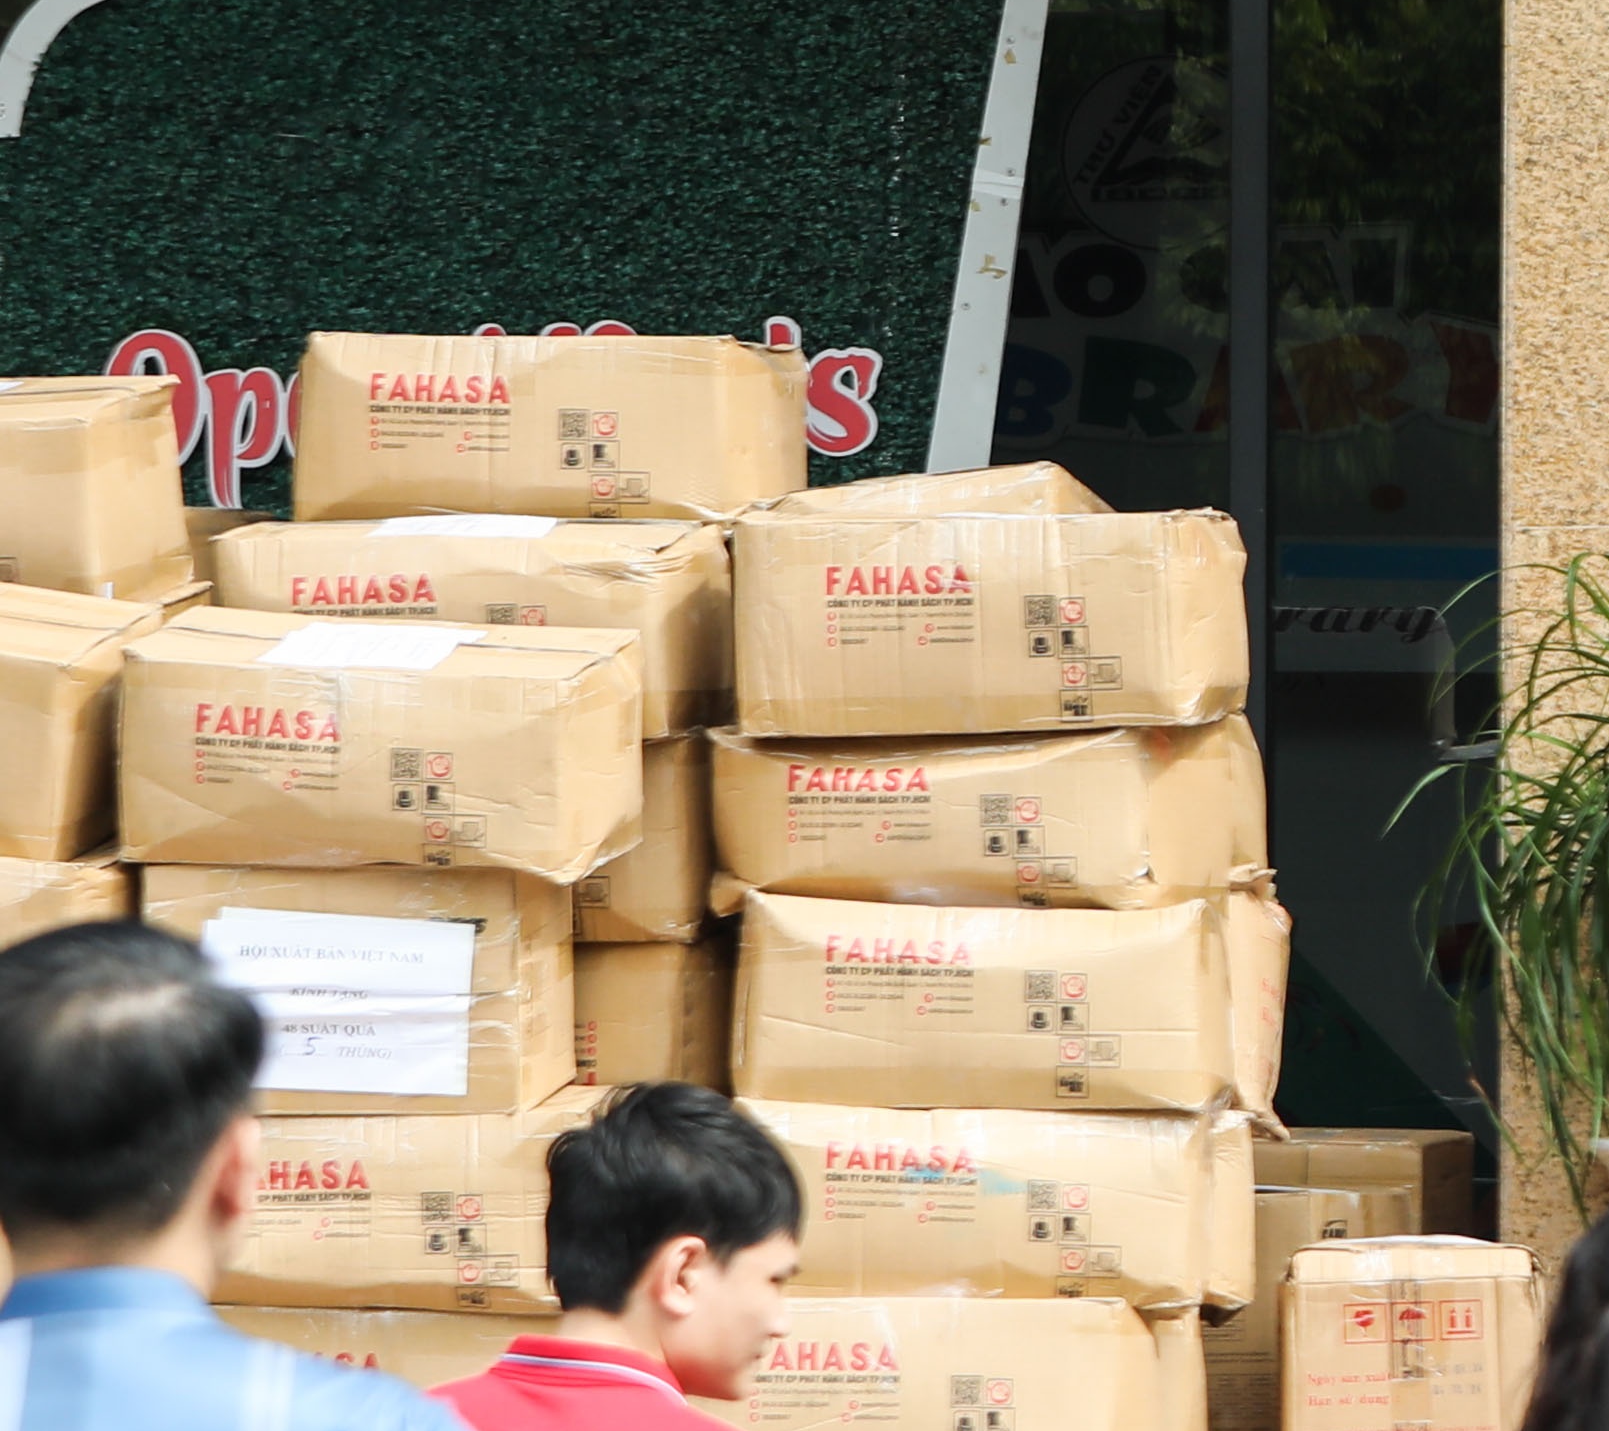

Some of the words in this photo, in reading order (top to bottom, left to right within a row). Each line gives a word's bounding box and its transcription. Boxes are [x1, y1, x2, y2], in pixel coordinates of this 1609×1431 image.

[369, 372, 511, 404] FAHASA
[291, 573, 437, 606] FAHASA
[825, 565, 973, 596] FAHASA
[194, 703, 343, 743] FAHASA
[787, 764, 930, 792] FAHASA
[388, 950, 425, 964] NAM
[825, 934, 974, 966] FAHASA
[825, 1140, 976, 1173] FAHASA
[768, 1341, 900, 1371] AHASA
